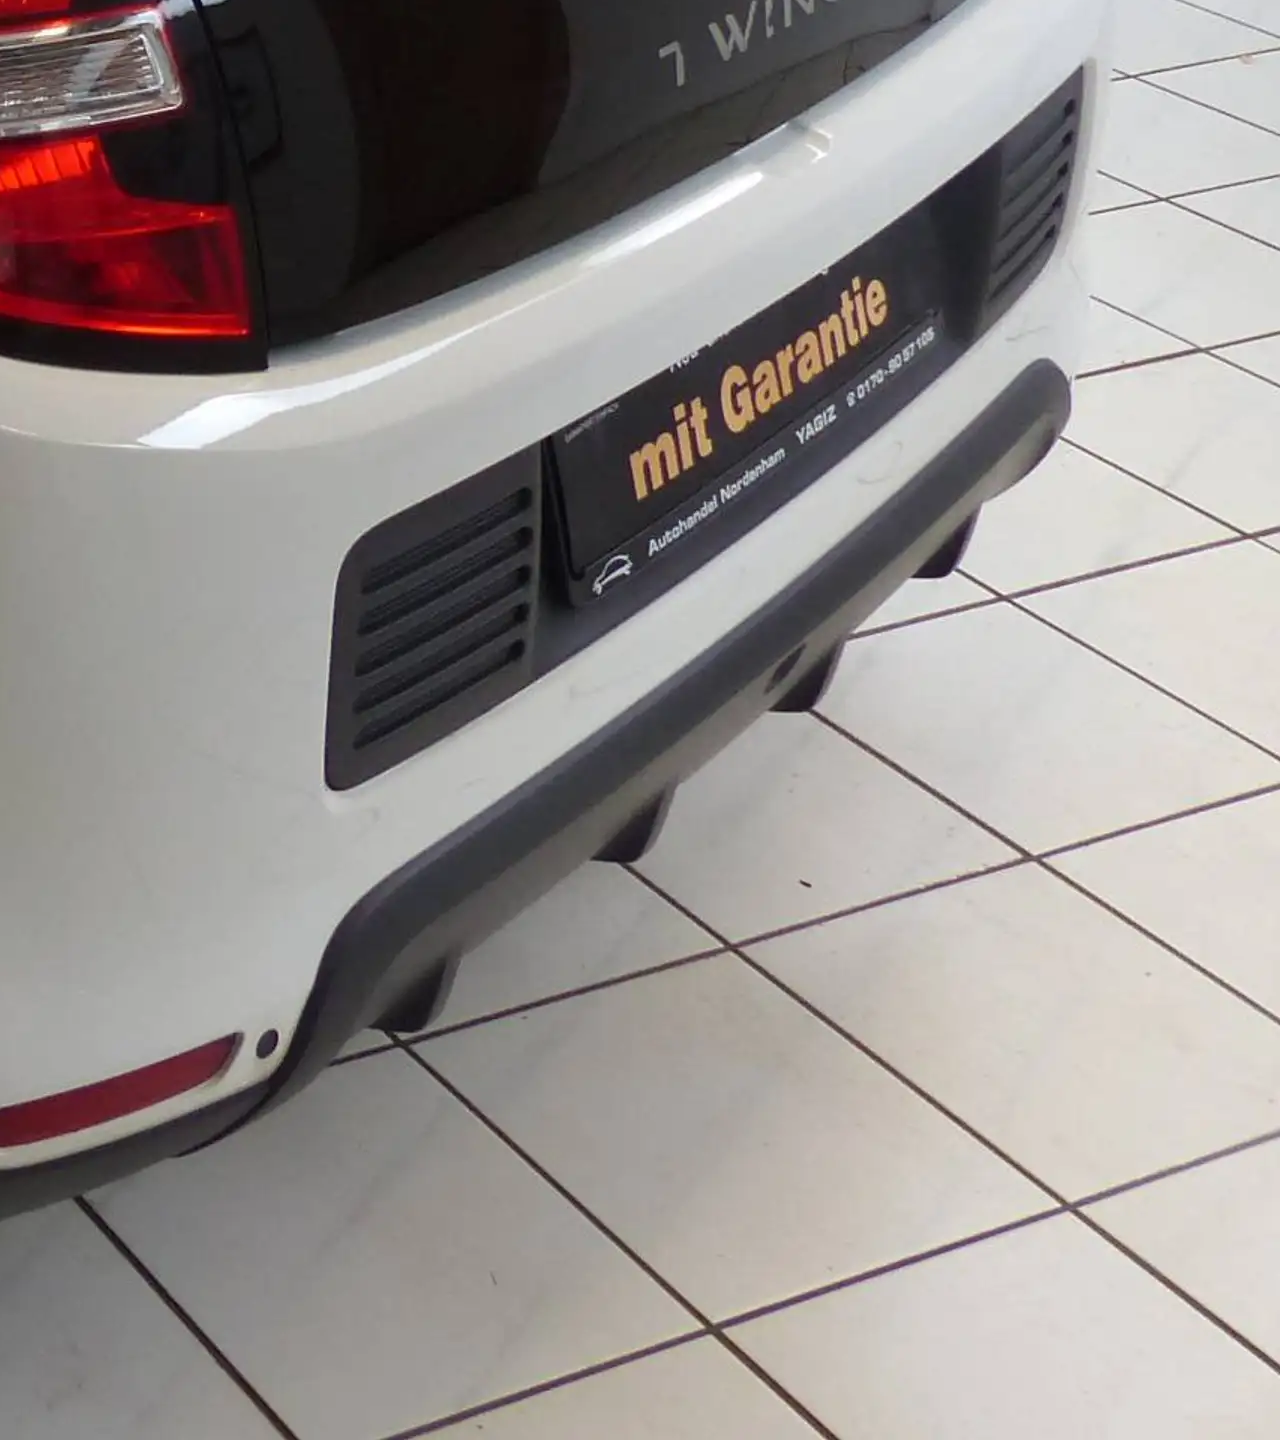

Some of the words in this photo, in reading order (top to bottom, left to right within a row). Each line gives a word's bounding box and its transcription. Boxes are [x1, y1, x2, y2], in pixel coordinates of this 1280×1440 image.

[629, 396, 713, 502] mit
[720, 276, 888, 434] Garantie
[648, 494, 718, 557] Autohandel
[720, 448, 786, 504] Nordenham
